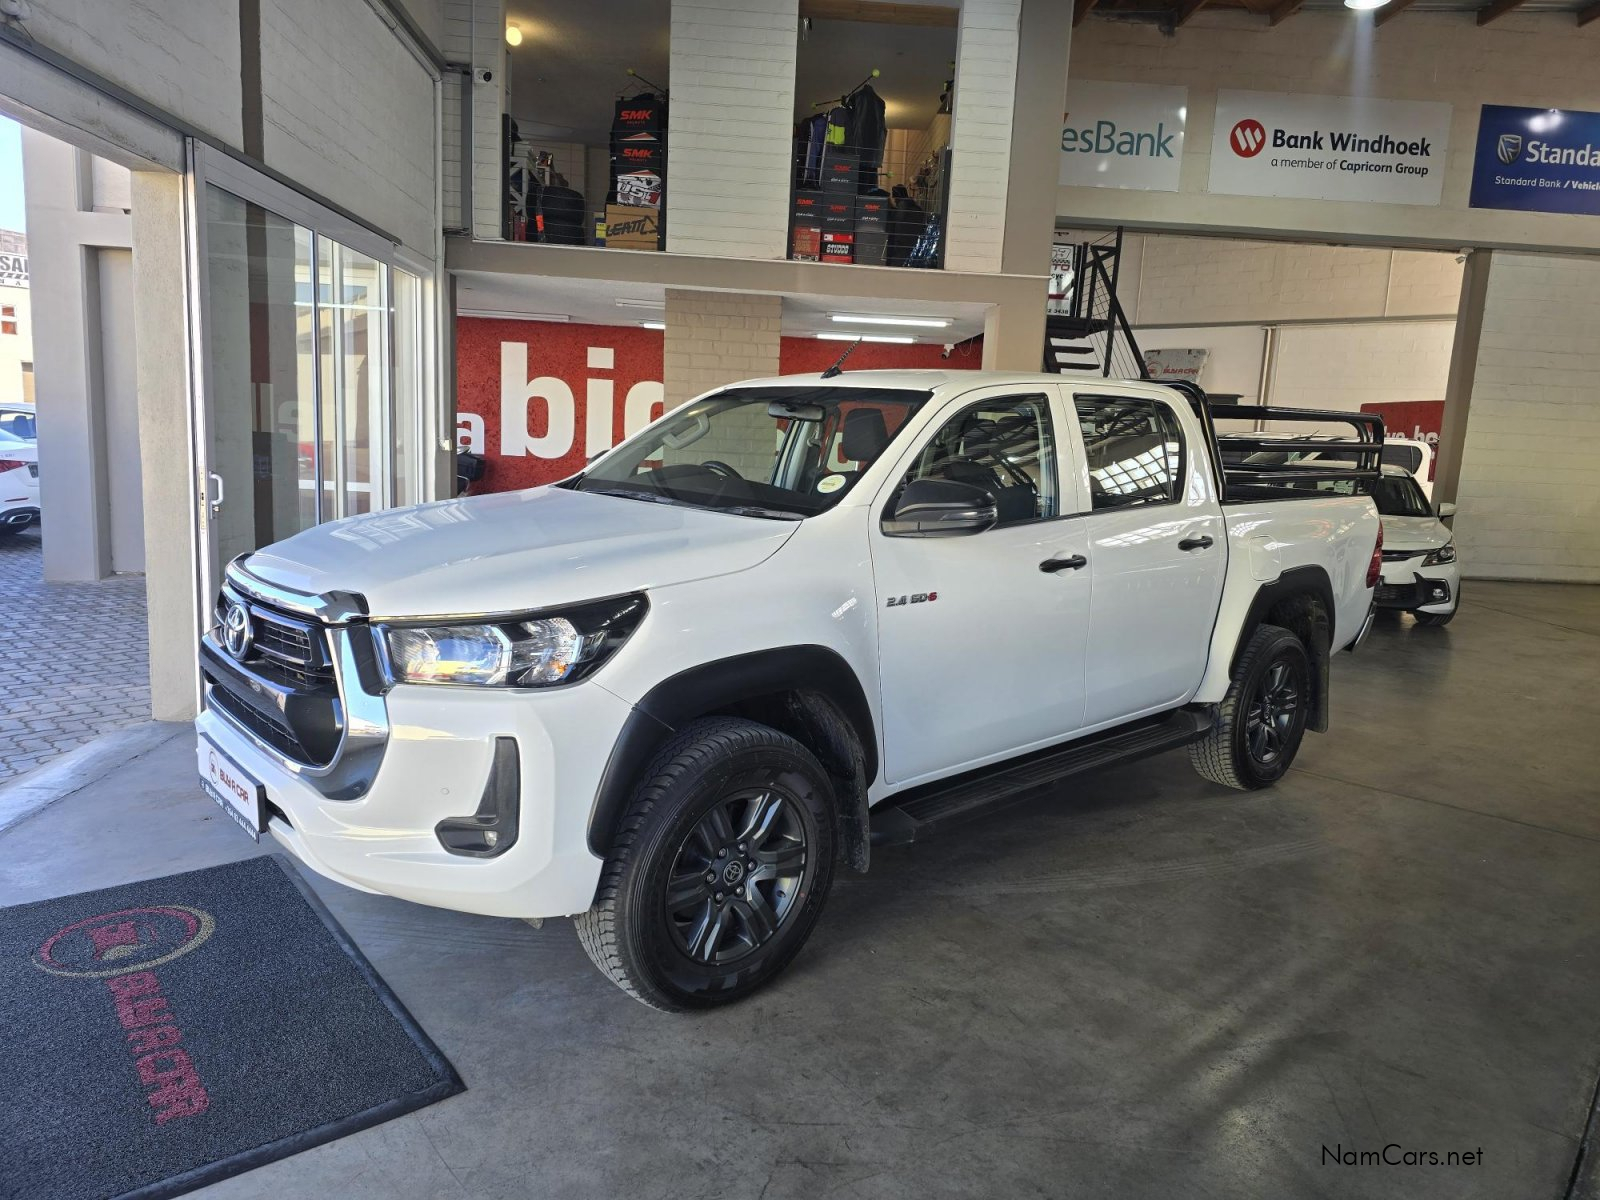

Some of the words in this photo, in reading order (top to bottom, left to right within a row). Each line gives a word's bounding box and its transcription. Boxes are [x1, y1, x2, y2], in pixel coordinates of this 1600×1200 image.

[620, 110, 652, 120] SMK
[1061, 120, 1174, 158] esBank
[1272, 129, 1323, 150] Bank
[1330, 132, 1431, 156] Windhoek
[622, 148, 653, 158] SMK
[1526, 140, 1600, 167] Standa
[1271, 159, 1278, 167] a
[1280, 158, 1324, 169] member
[1326, 159, 1338, 170] of
[1339, 160, 1392, 174] Capricorn
[1395, 163, 1429, 178] Group
[1495, 176, 1537, 187] Standard
[1539, 179, 1561, 188] Bank
[887, 595, 907, 607] 2.4
[220, 768, 232, 789] BUY
[232, 779, 237, 793] A
[237, 785, 249, 804] CAR
[105, 971, 174, 1029] BUY
[127, 1026, 183, 1053] A
[136, 1049, 209, 1126] CAR
